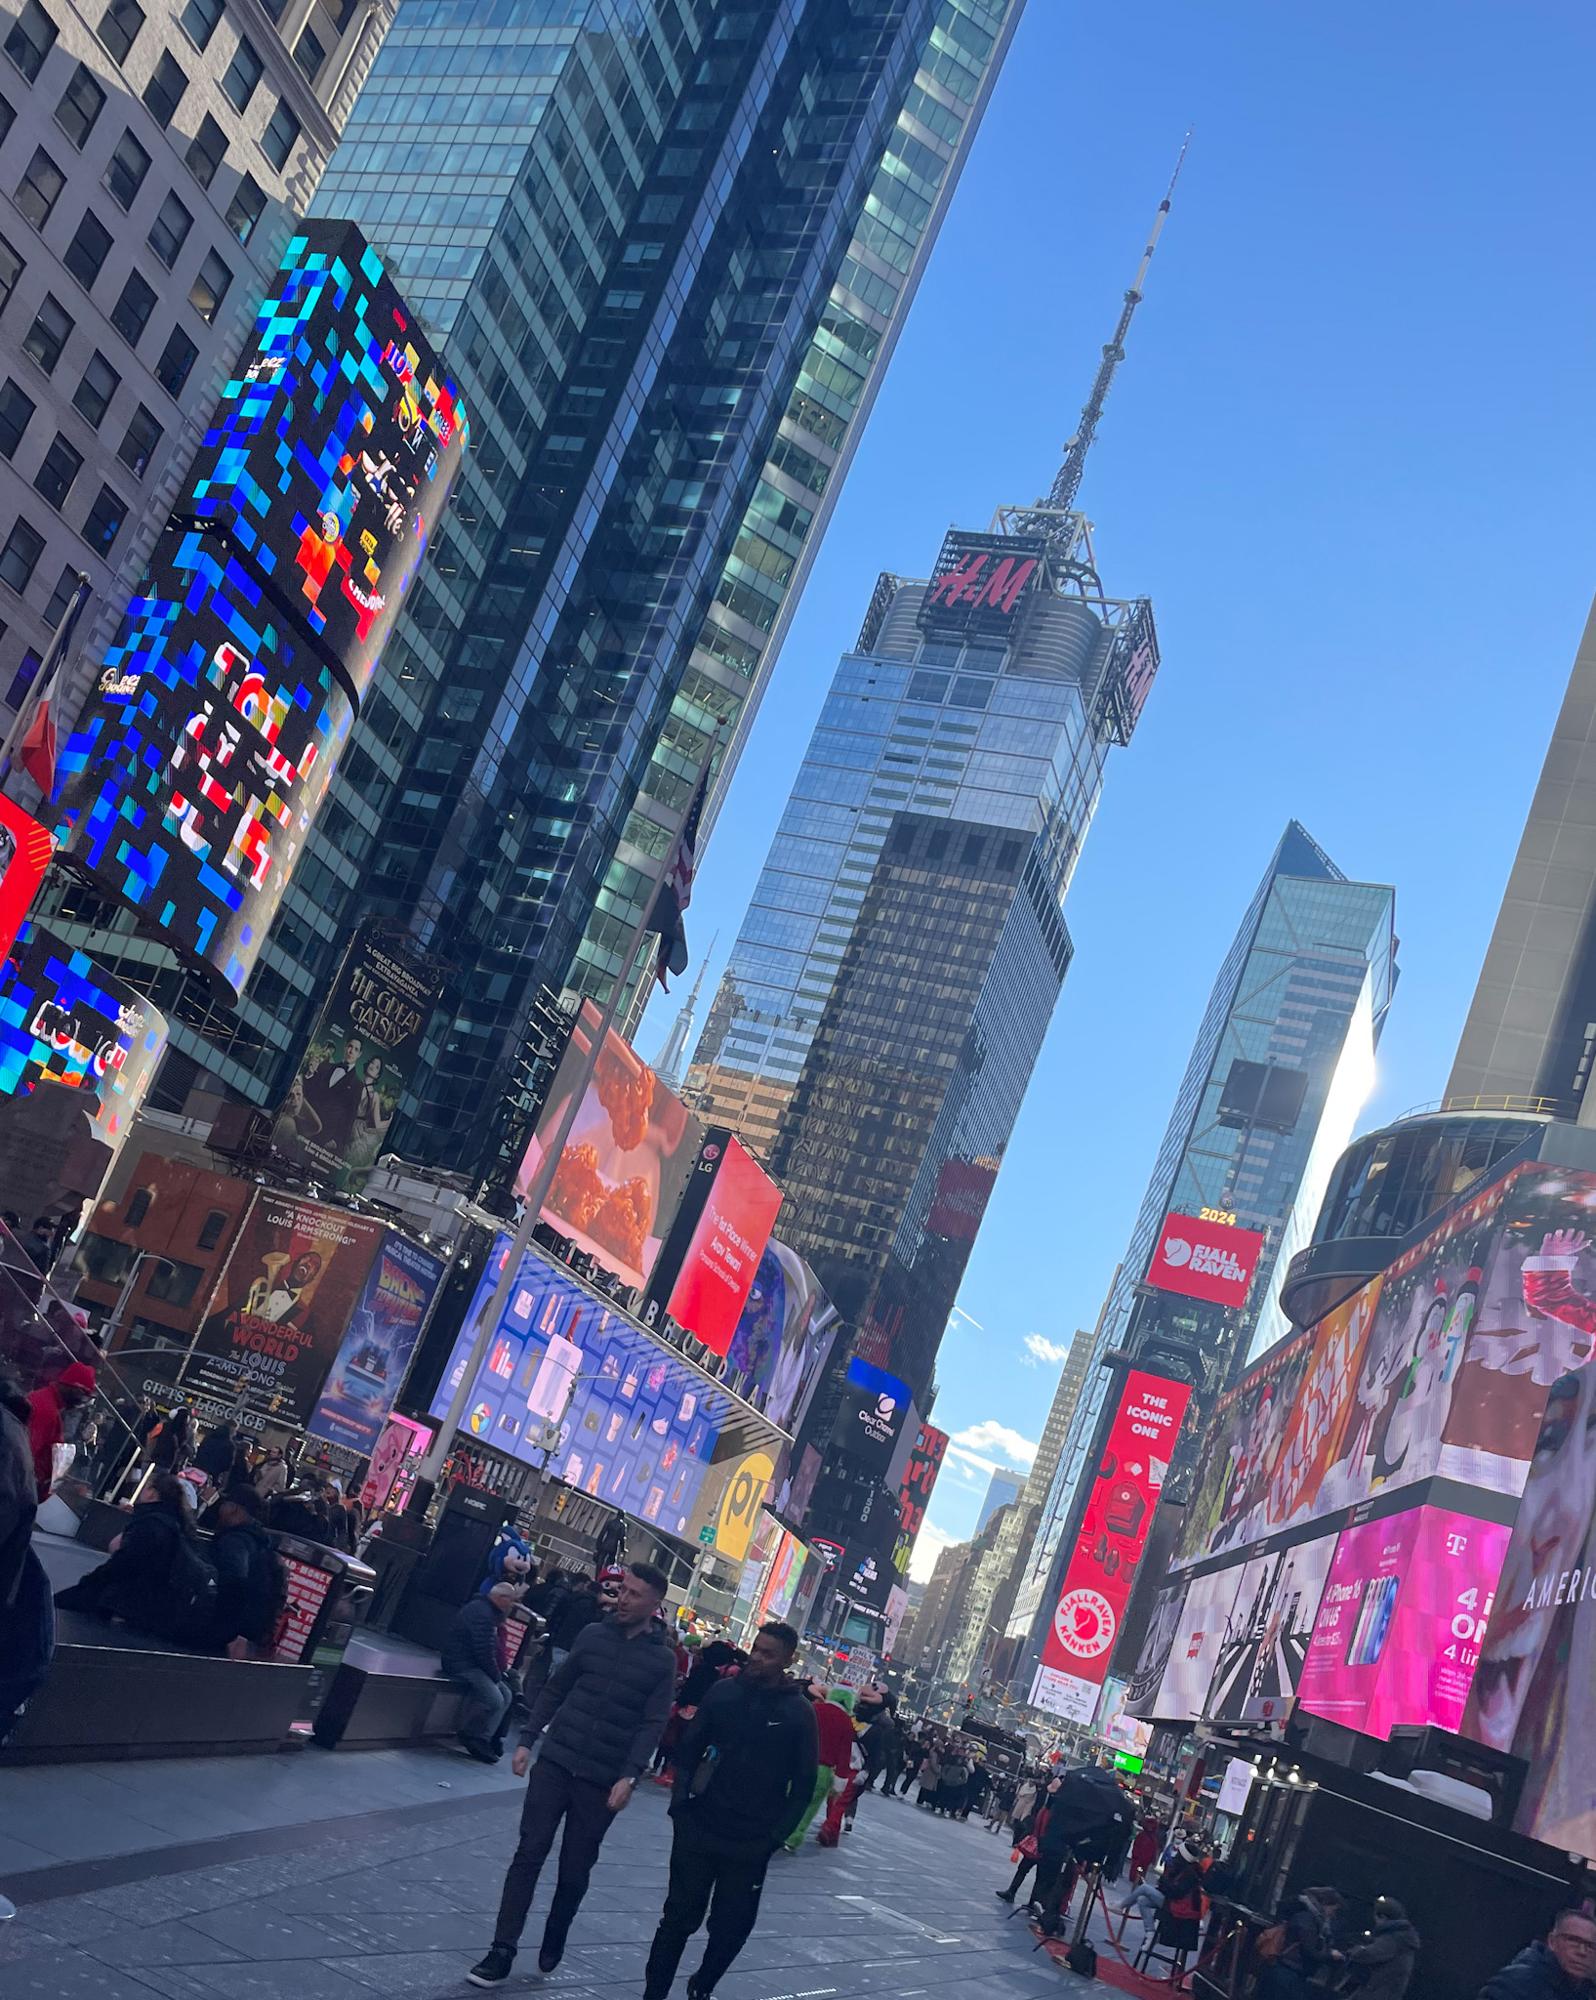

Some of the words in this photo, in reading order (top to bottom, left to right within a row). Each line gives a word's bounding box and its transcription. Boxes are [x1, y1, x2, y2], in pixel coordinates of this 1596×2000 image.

[931, 553, 1039, 614] H&M
[375, 961, 419, 997] EXTRAVAGANZA
[401, 969, 433, 997] BROADWAY
[350, 972, 378, 1002] THE
[376, 990, 422, 1034] GREAT
[349, 999, 409, 1047] GATSBY
[697, 1160, 714, 1174] LG
[266, 1213, 293, 1229] LOUIS
[295, 1213, 345, 1233] KNOCKOUT
[1198, 1206, 1237, 1227] 2024
[240, 1312, 313, 1349] WONDERFUL
[232, 1327, 299, 1363] WORLD
[240, 1349, 287, 1376] LOUIS
[142, 1378, 186, 1403] GIFTS
[195, 1397, 266, 1432] LUGGAGE
[1142, 1392, 1169, 1410] THE
[1126, 1405, 1173, 1428] ICONIC
[1131, 1422, 1160, 1440] ONE
[1457, 1586, 1479, 1611] 4
[852, 1648, 874, 1660] ONLY
[1443, 1644, 1457, 1660] 4
